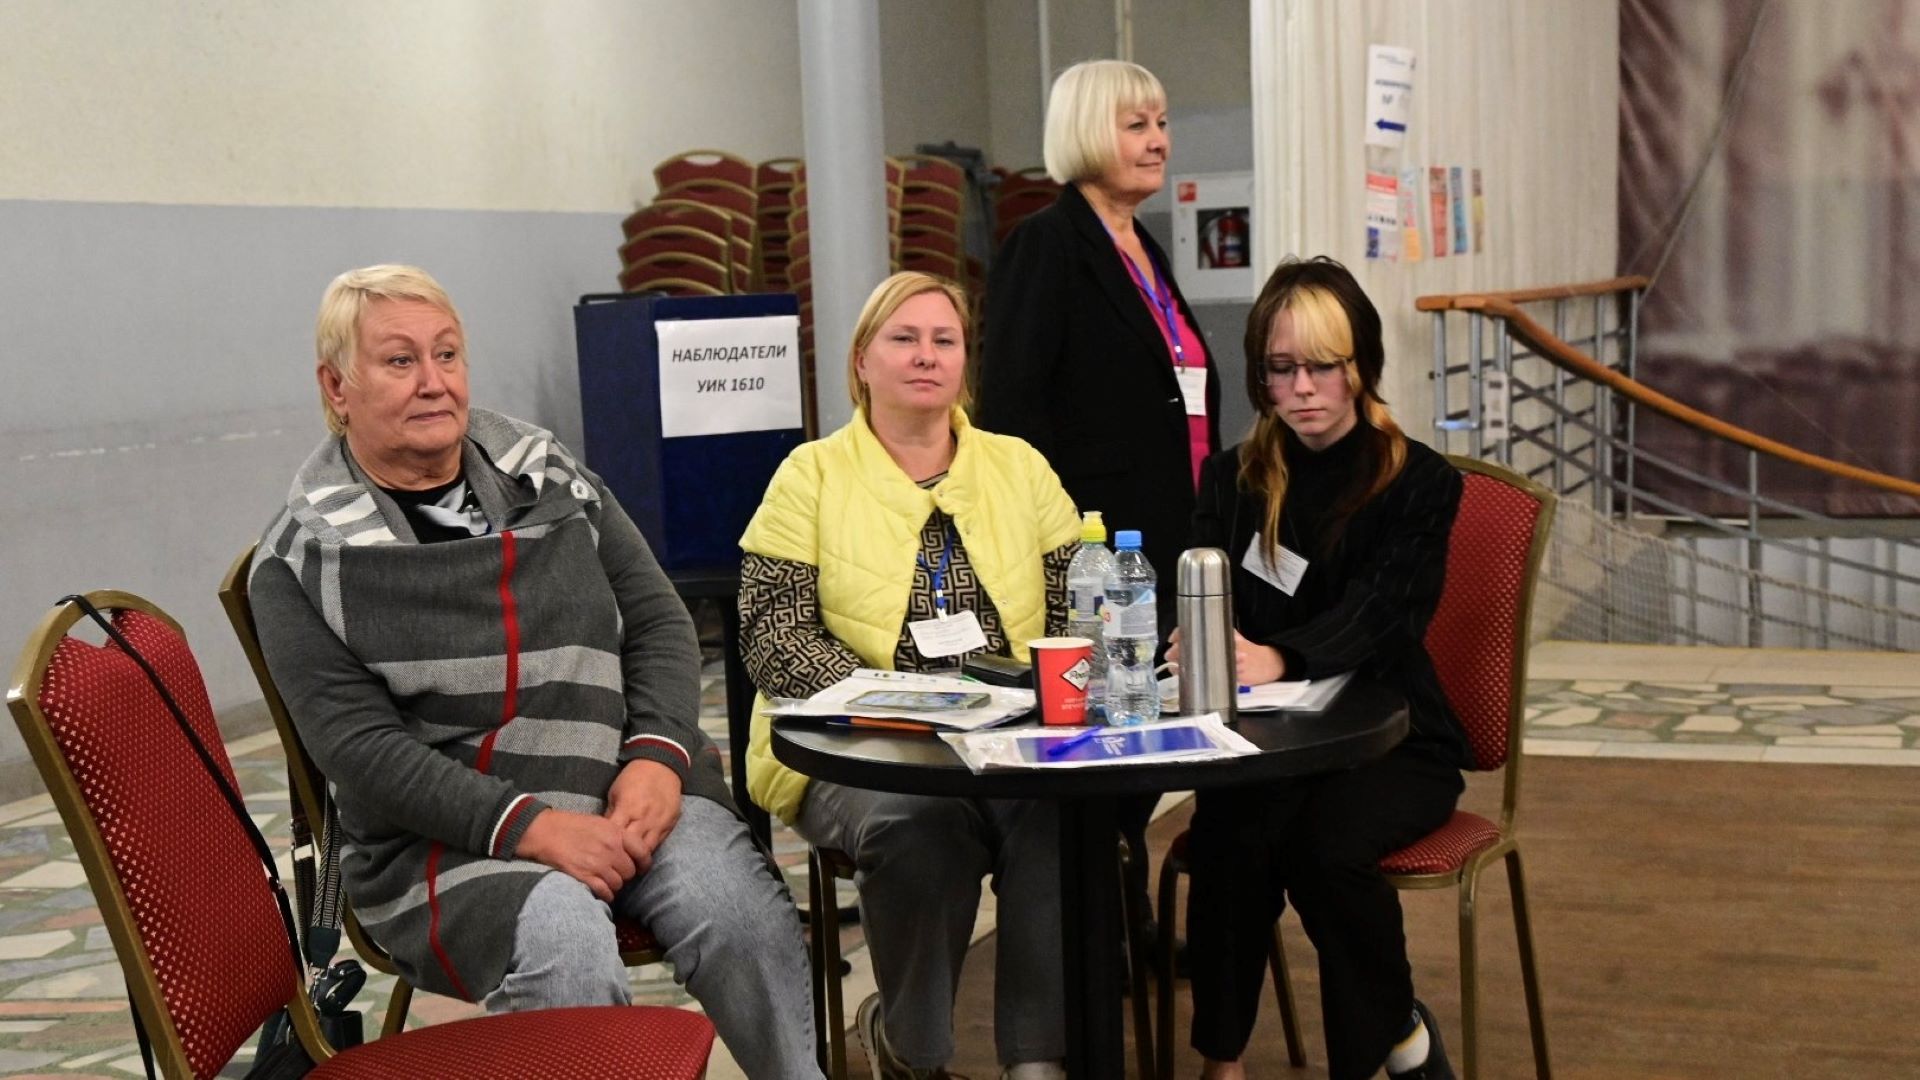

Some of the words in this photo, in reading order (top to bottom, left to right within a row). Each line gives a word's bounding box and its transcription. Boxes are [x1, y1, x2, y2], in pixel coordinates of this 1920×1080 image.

[672, 345, 787, 363] НАБЛЮДАТЕЛИ
[697, 379, 727, 394] УИК
[731, 377, 765, 392] 1610
